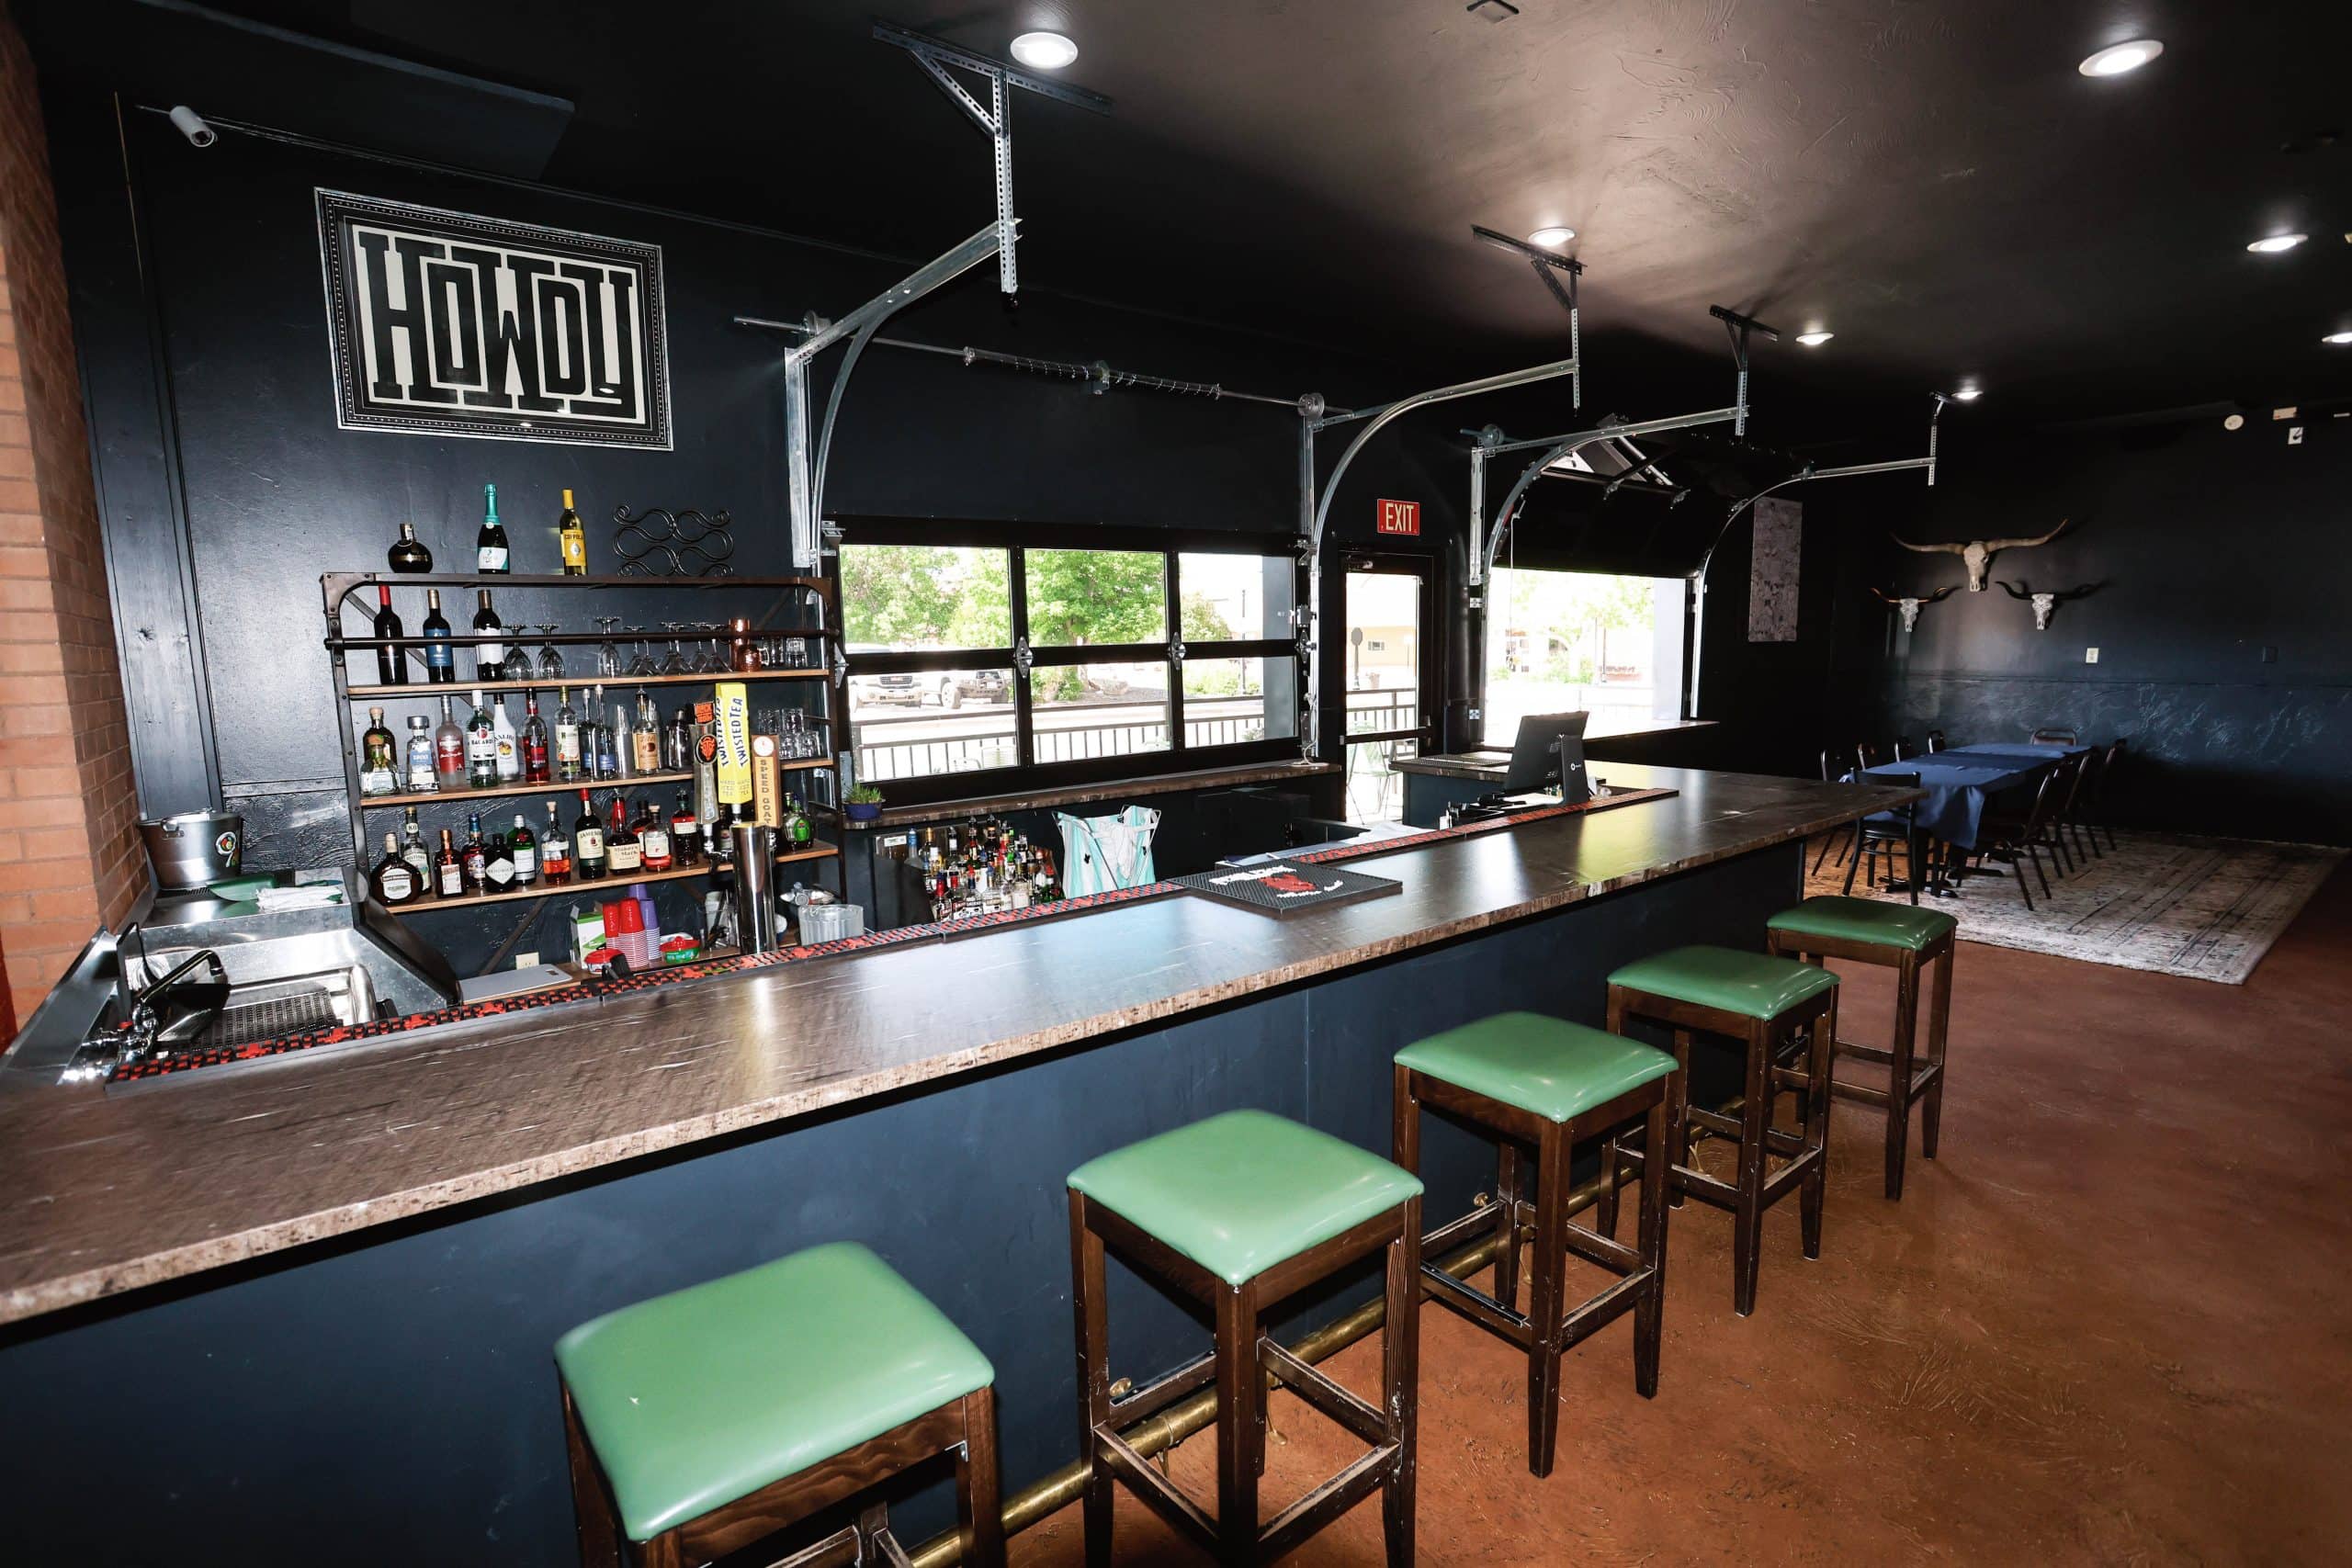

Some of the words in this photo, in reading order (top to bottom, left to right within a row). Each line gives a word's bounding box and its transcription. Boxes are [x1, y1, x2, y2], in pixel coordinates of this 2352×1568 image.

[356, 228, 639, 422] HOWDY
[1385, 502, 1414, 532] EXIT
[729, 697, 744, 719] TEA
[730, 720, 750, 768] TWISTED
[760, 759, 771, 794] SPEED
[762, 796, 773, 824] GOAT
